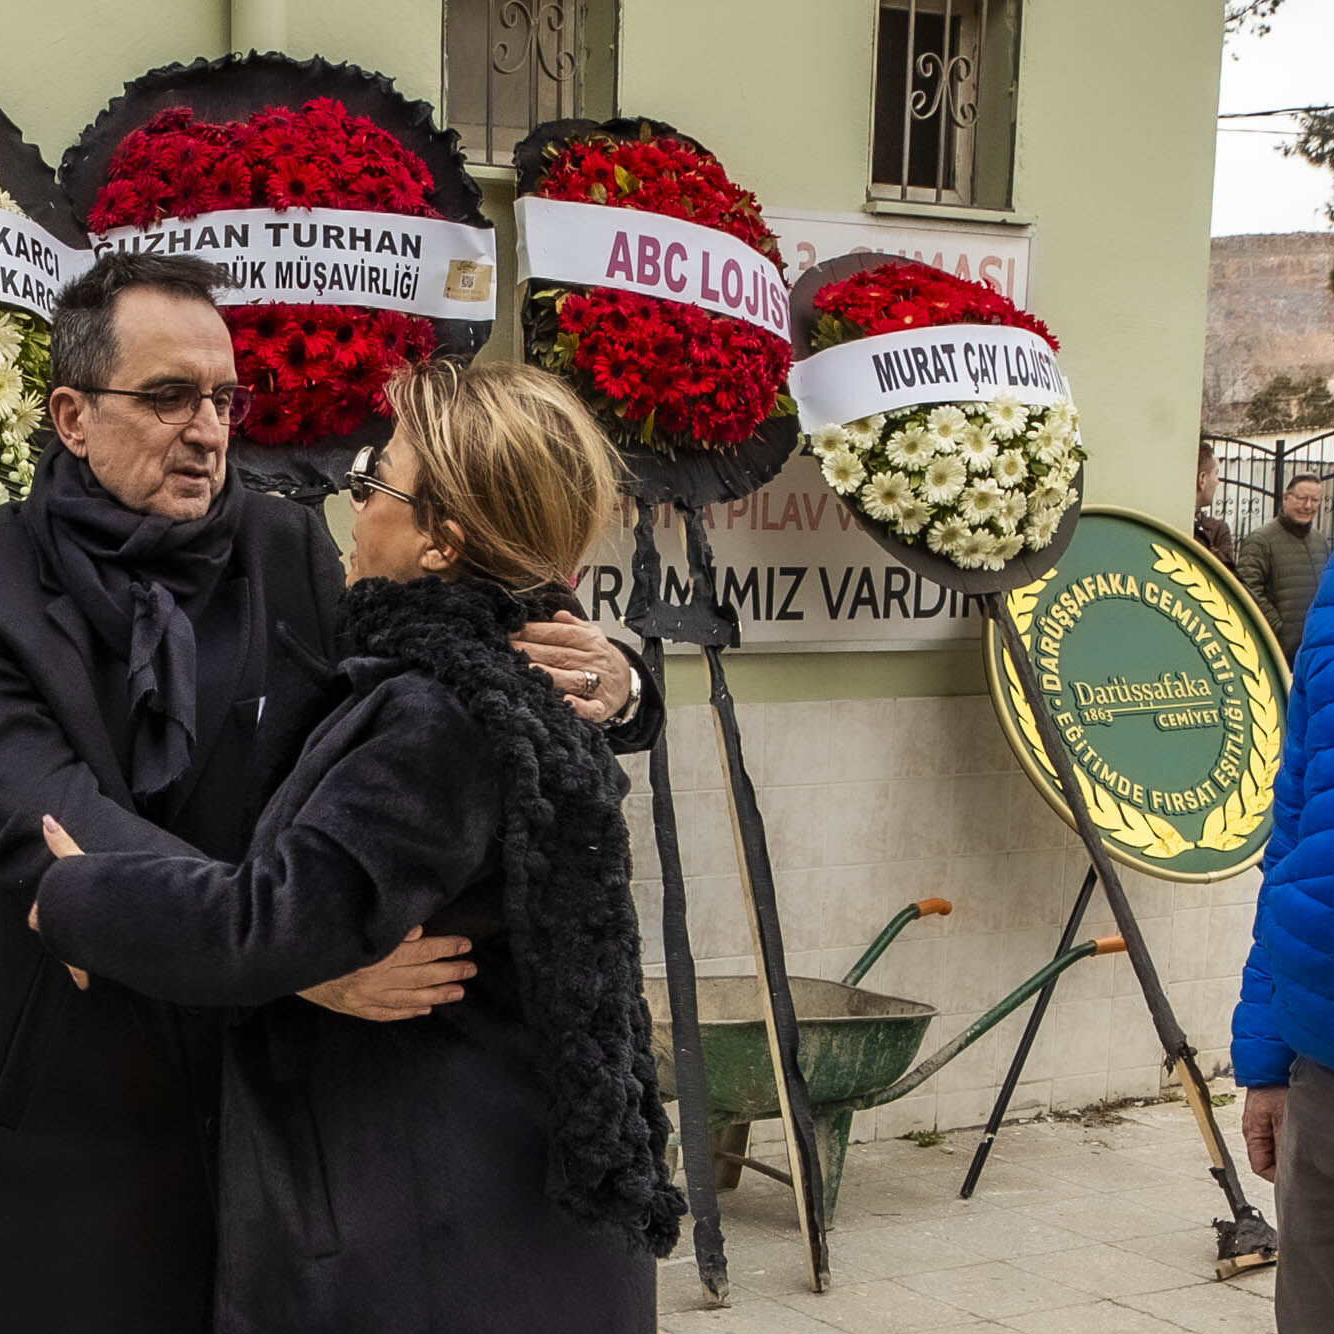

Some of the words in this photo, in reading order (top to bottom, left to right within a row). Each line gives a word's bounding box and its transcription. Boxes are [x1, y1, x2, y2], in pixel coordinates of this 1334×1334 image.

[264, 223, 423, 260] TURHAN
[606, 230, 688, 294] ABC
[275, 255, 420, 301] MÜŞAVİRLİĞİ
[873, 342, 961, 394] MURAT
[962, 342, 999, 394] ÇAY
[1040, 573, 1142, 692] DARÜŞŞAFAKA
[1082, 707, 1114, 723] 1863
[1056, 711, 1145, 805] EĞİTİMDE
[1152, 780, 1219, 813] FIRSAT
